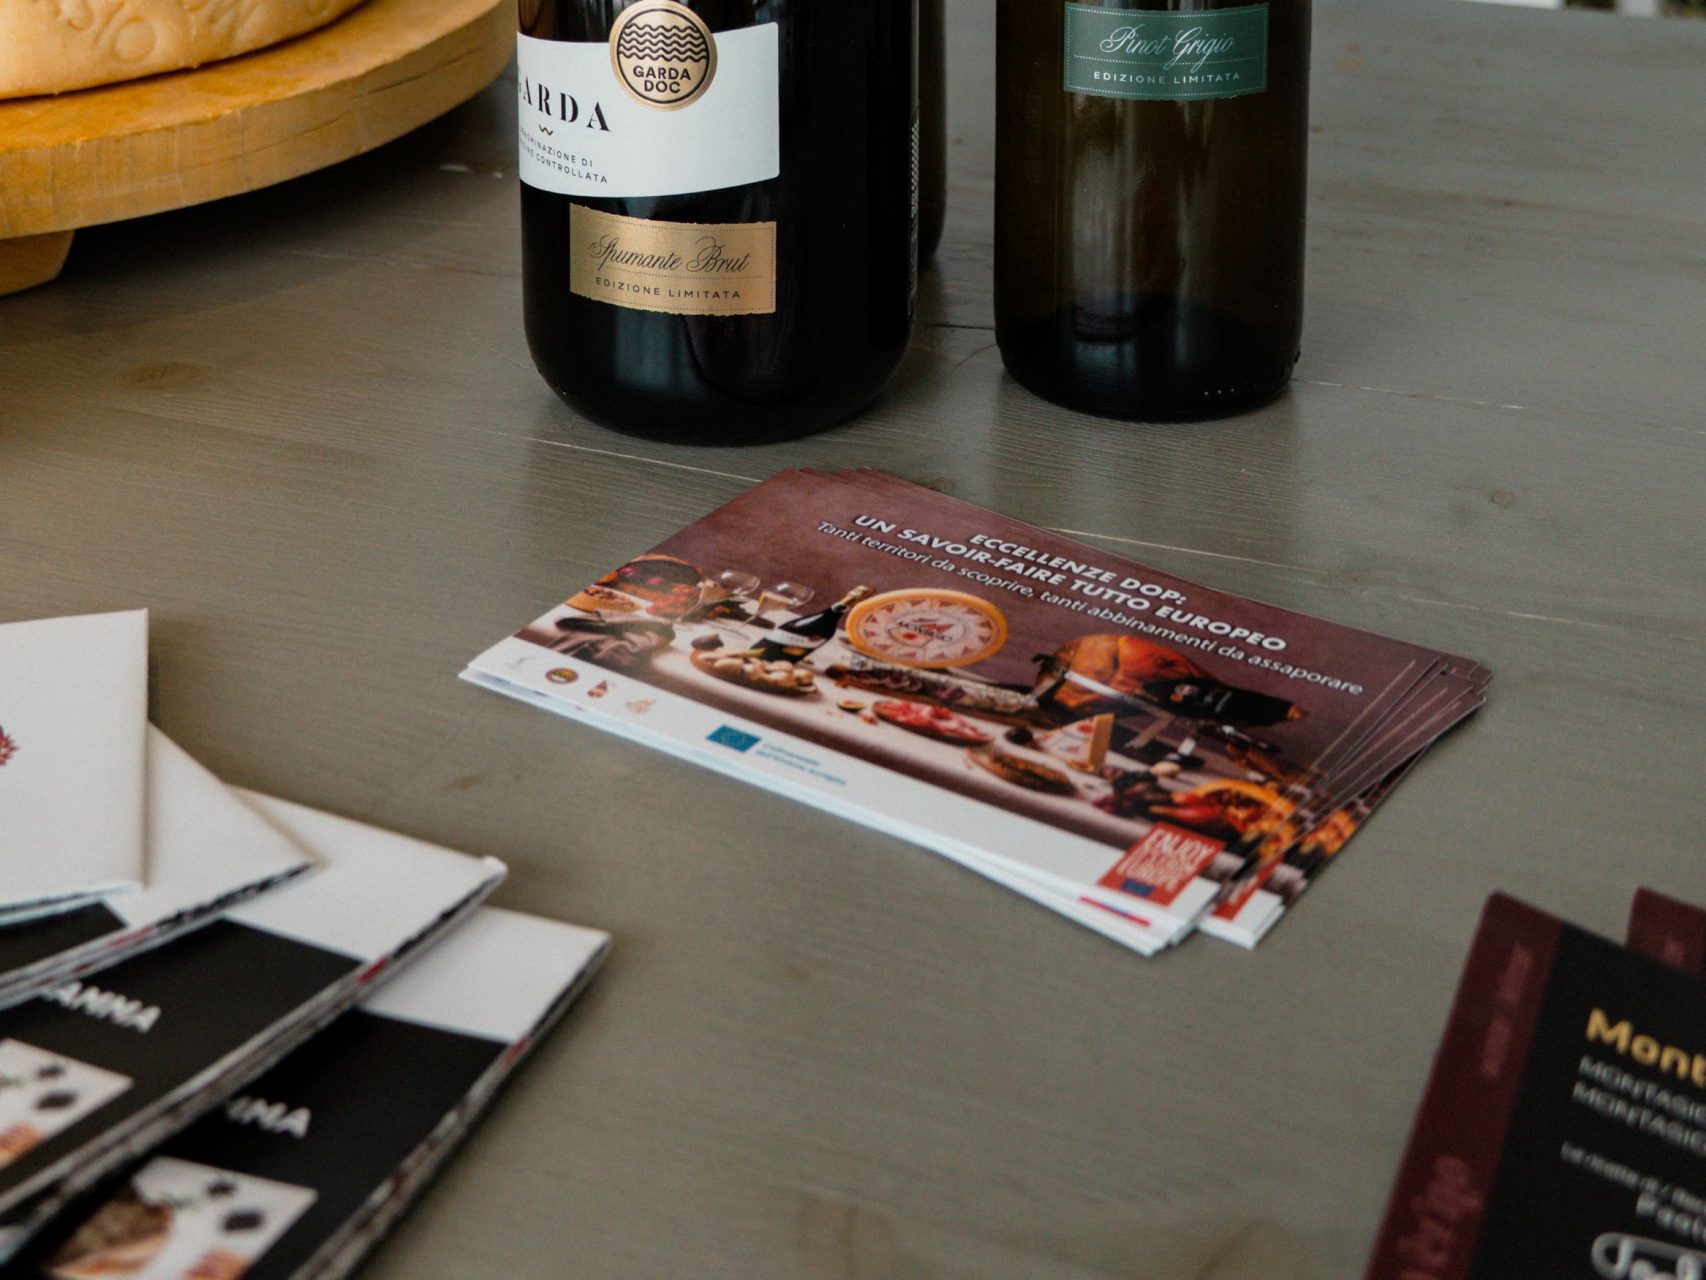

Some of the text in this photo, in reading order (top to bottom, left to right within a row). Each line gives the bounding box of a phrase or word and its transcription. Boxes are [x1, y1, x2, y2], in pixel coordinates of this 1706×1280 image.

[1099, 24, 1234, 72] Pinot Grigio
[633, 65, 692, 81] GARDA
[643, 80, 681, 94] DOC
[1093, 71, 1241, 85] EDIZIONE LIMITATA
[519, 75, 612, 132] ARDA
[536, 152, 608, 184] CONTROLLATA
[581, 157, 593, 168] DI
[589, 234, 751, 275] Spumante Brut
[595, 277, 741, 300] EDIZIONE LIMITATA
[854, 513, 1287, 653] UN SAVOIR-FAIRE TUTTO EUROPEO
[968, 532, 1188, 607] ECCELLENZE DOP:
[817, 520, 1364, 698] Tanti territori da scoprire, tanti abbinamenti da assaporare
